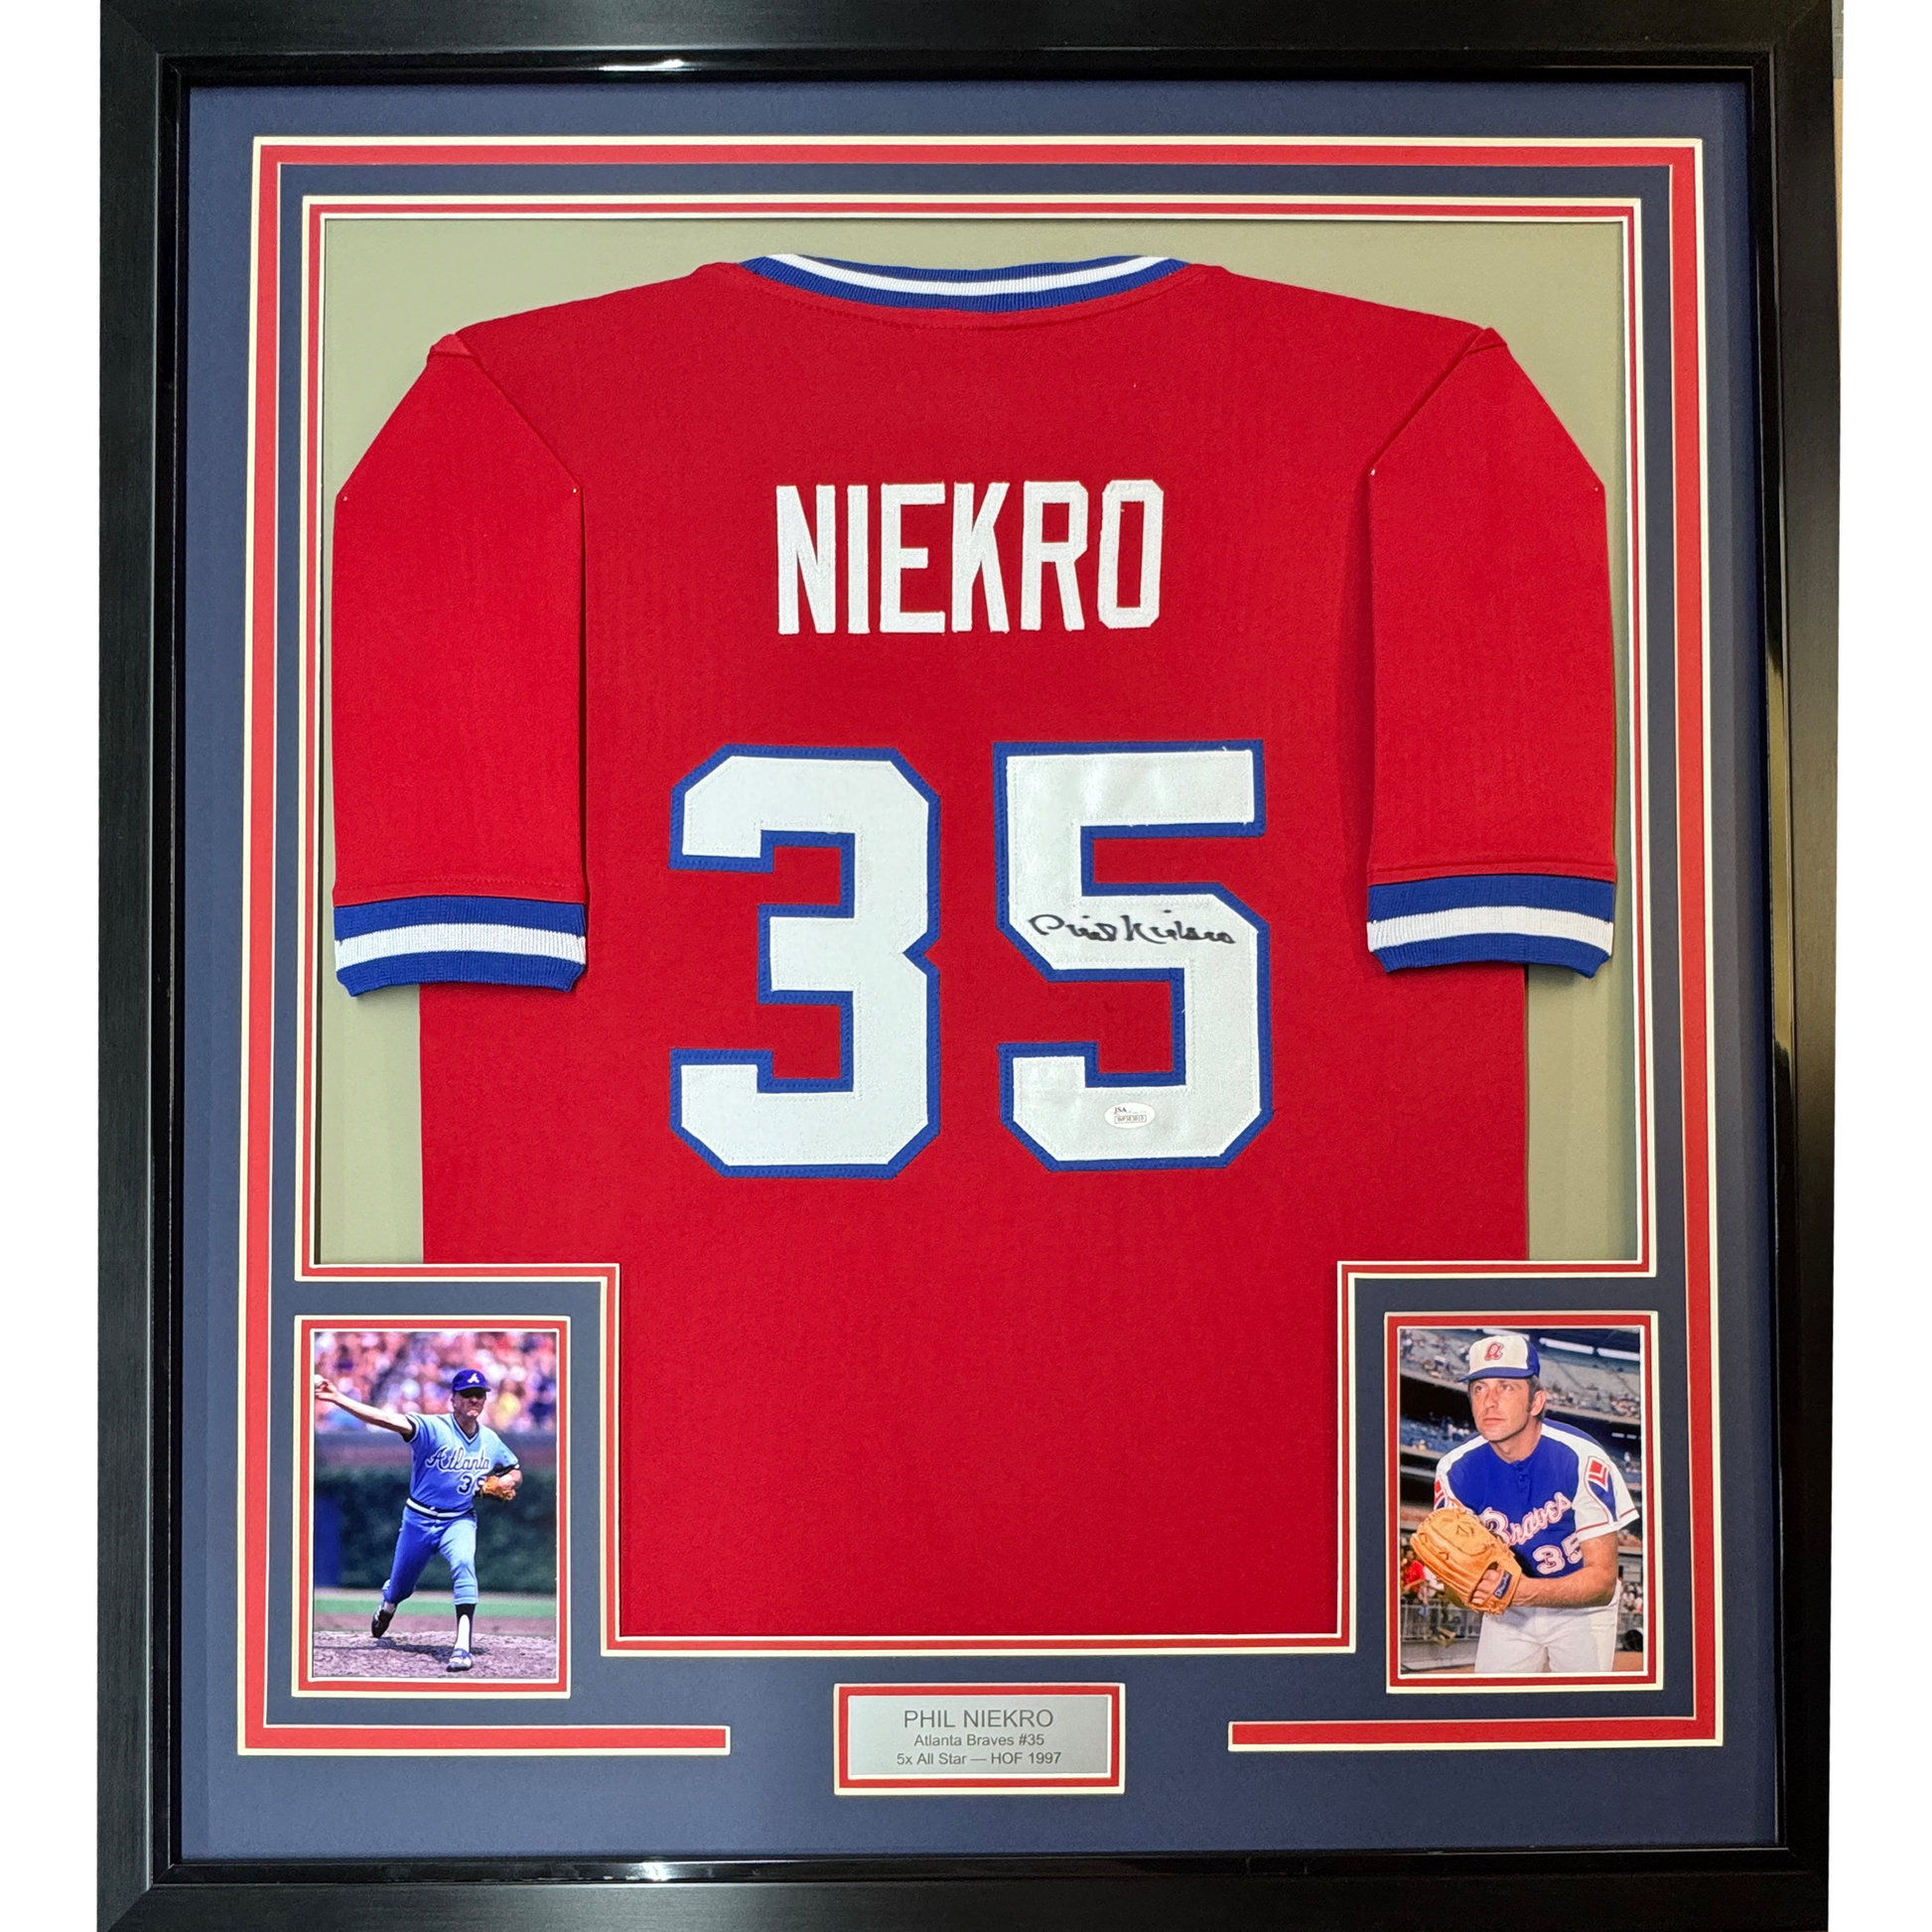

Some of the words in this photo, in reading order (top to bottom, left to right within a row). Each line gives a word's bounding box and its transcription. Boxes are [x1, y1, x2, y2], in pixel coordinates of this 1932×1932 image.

[775, 479, 1165, 635] NIEKRO
[669, 740, 1274, 1180] 35
[425, 1445, 492, 1472] Atlanta
[1478, 1491, 1573, 1546] Braves
[1532, 1532, 1585, 1576] 35
[903, 1710, 956, 1728] PHIL
[963, 1709, 1054, 1728] NIEKRO
[913, 1733, 962, 1747] Atlanta
[966, 1733, 1015, 1746] Braves
[1018, 1733, 1045, 1746] #35
[896, 1752, 913, 1765] 5x
[916, 1752, 934, 1765] All
[938, 1752, 968, 1765] Star
[991, 1751, 1024, 1765] HOF
[1028, 1751, 1062, 1765] 1997
